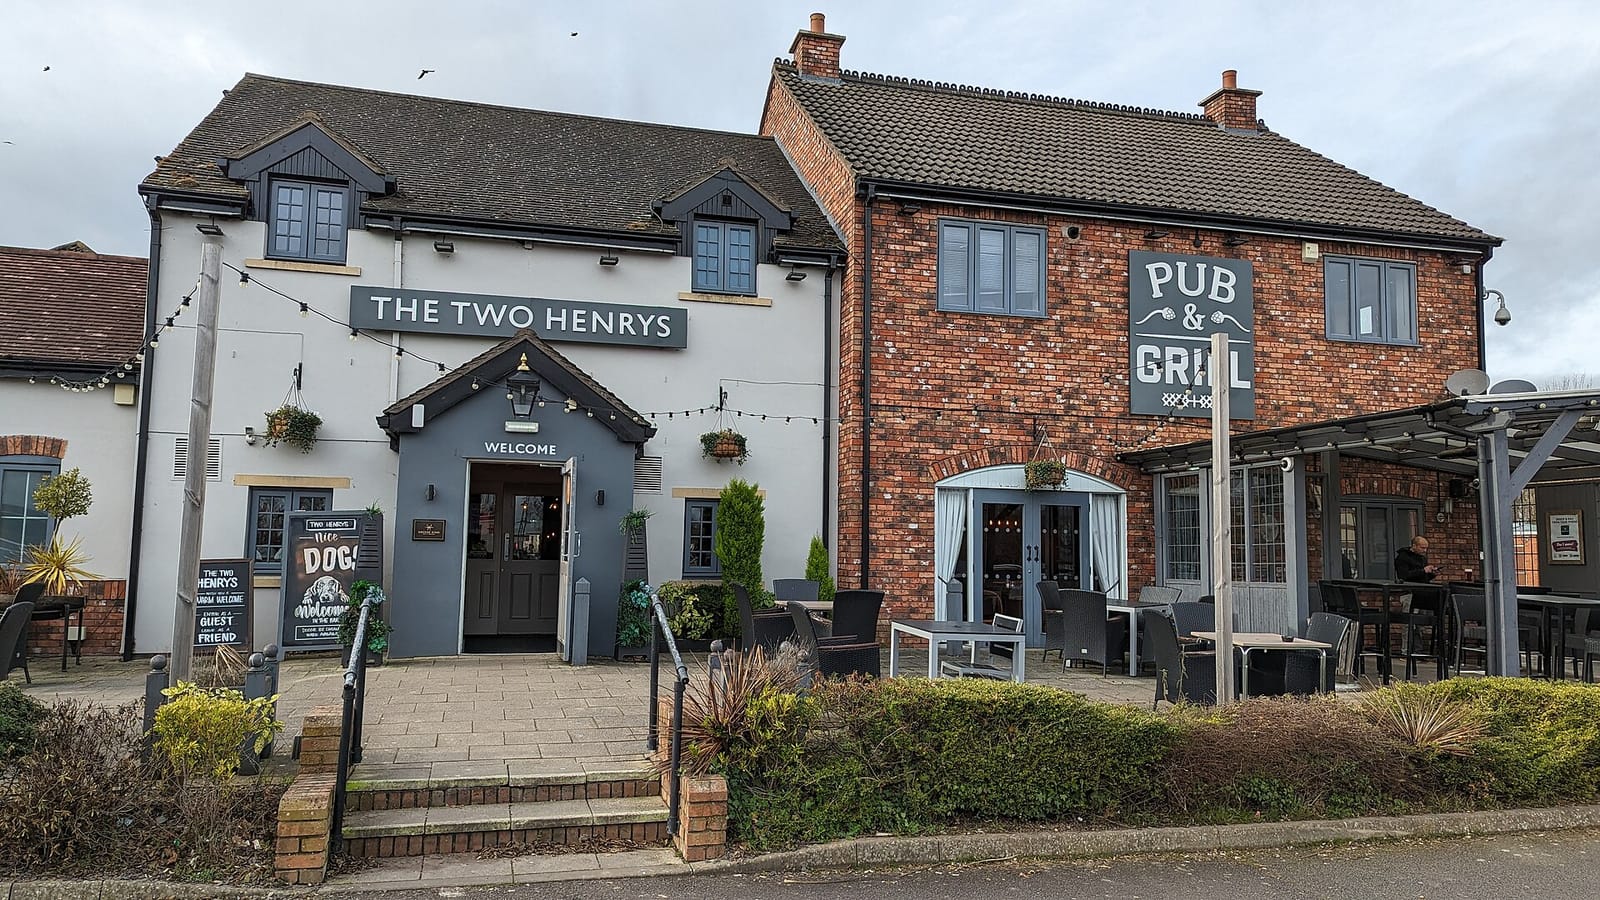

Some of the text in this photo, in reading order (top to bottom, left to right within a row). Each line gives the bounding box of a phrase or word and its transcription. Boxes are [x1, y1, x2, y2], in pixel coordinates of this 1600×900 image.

[1145, 261, 1237, 304] PUB
[370, 296, 671, 337] THE TWO HENRYS
[1182, 303, 1206, 331] &
[484, 442, 557, 455] WELCOME
[203, 569, 234, 577] THE TWO
[197, 577, 238, 588] HENRYS
[200, 616, 234, 627] GUEST
[198, 632, 237, 644] FRIEND
